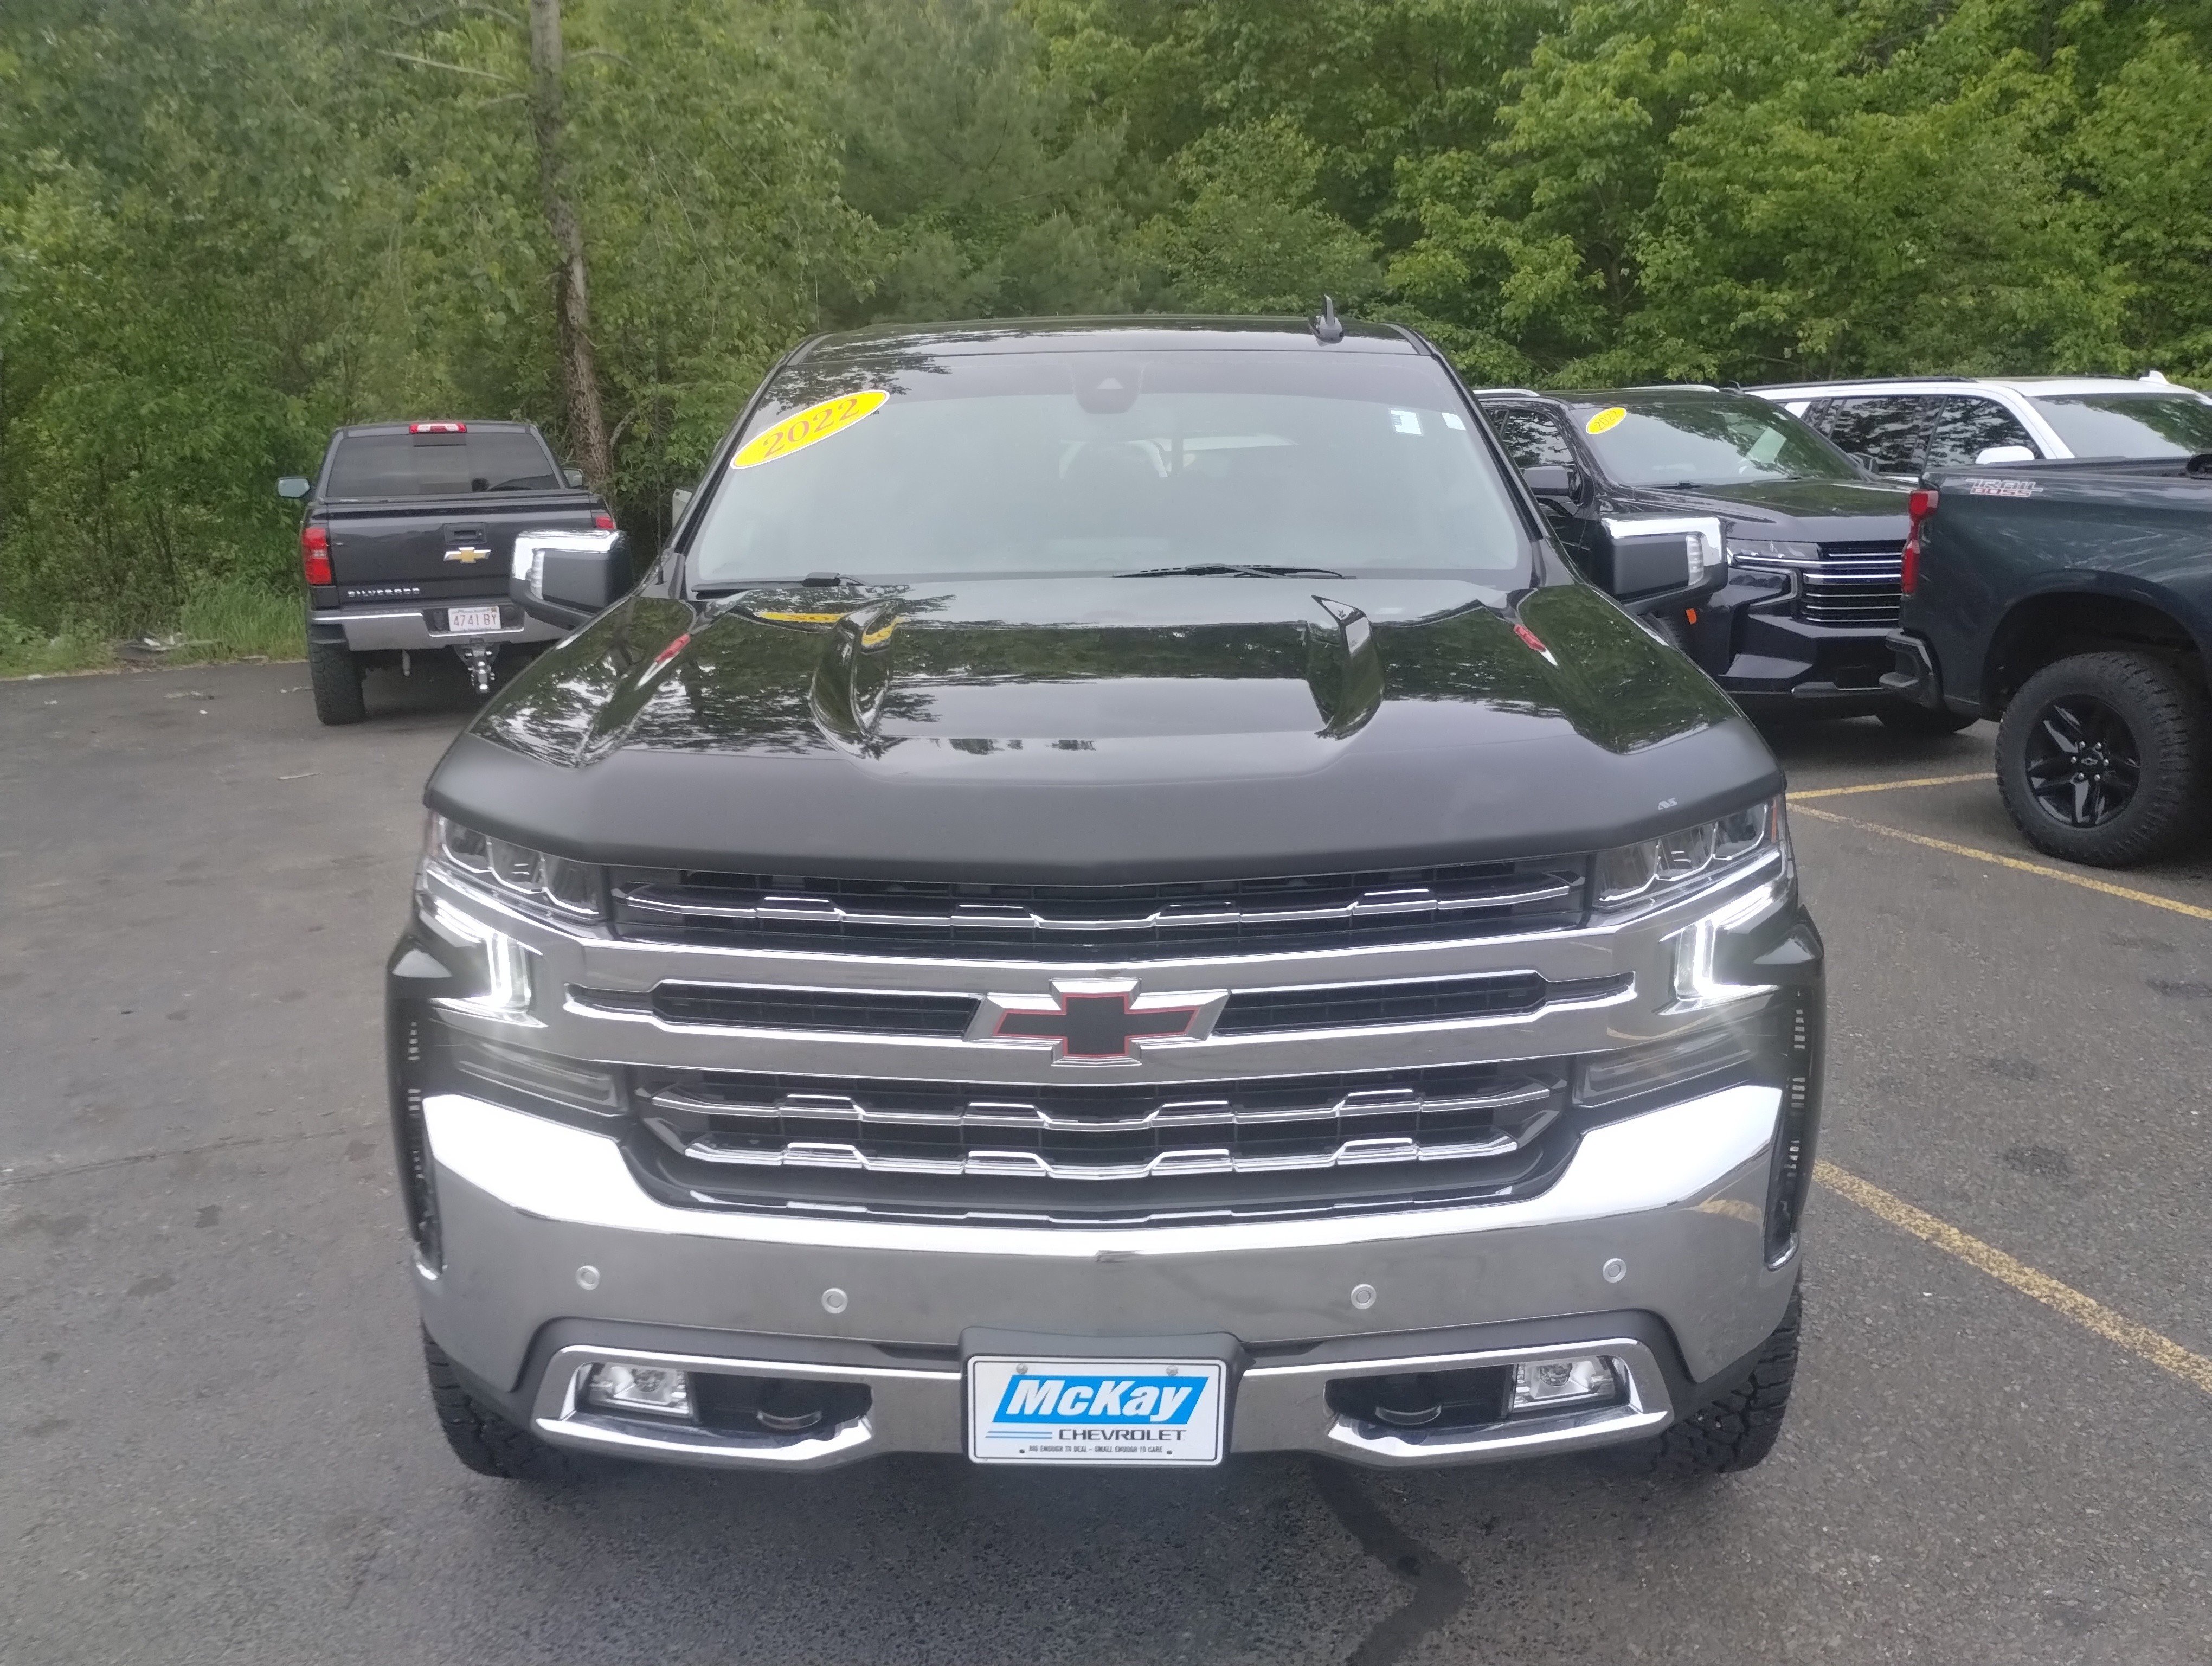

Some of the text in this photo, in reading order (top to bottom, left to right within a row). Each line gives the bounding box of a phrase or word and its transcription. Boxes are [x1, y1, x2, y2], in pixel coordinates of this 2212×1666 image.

[762, 398, 860, 459] 2022
[1593, 410, 1621, 431] 2022
[453, 613, 497, 626] 4741 BY
[1005, 1379, 1193, 1423] McKay
[1058, 1429, 1187, 1441] CHEVROLET
